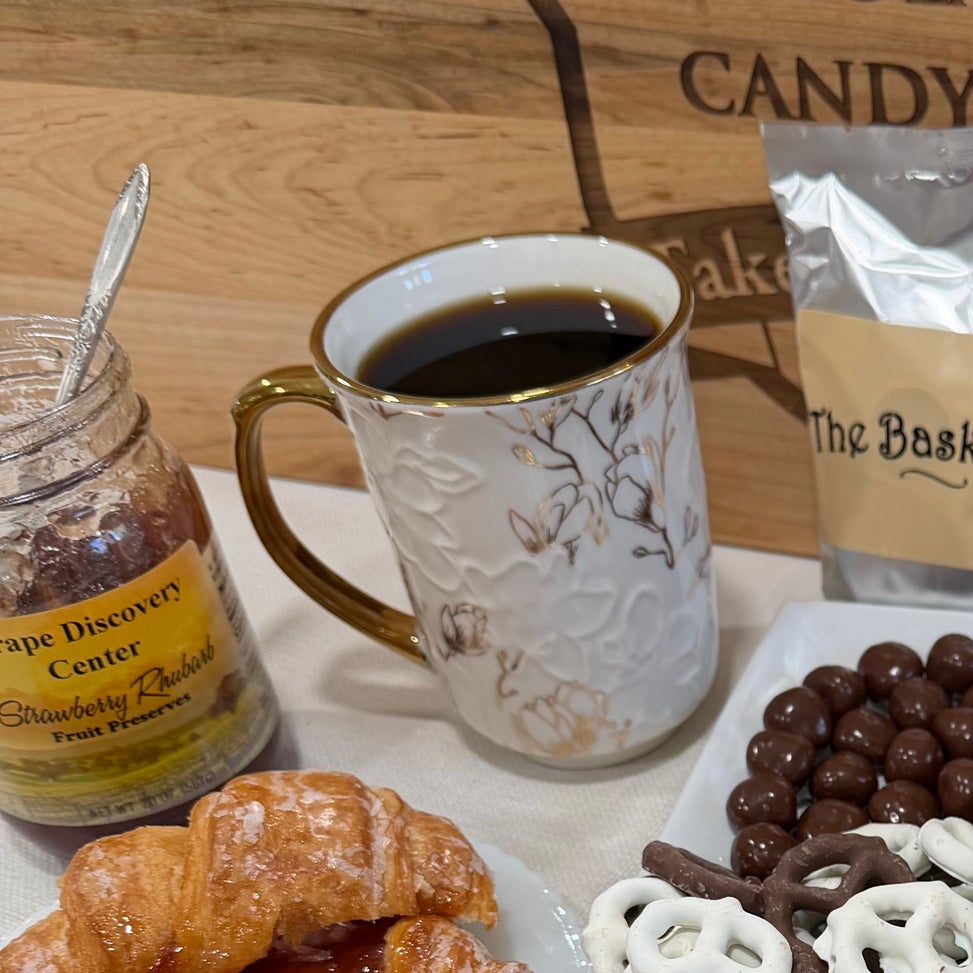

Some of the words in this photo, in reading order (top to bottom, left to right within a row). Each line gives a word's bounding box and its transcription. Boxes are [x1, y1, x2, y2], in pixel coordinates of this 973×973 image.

[809, 408, 869, 458] The
[60, 578, 181, 643] Discovery
[0, 693, 129, 727] Strawberry
[129, 635, 215, 705] Rhubarb
[48, 640, 142, 680] Center
[51, 726, 104, 743] Fruit
[109, 692, 192, 733] Preserves
